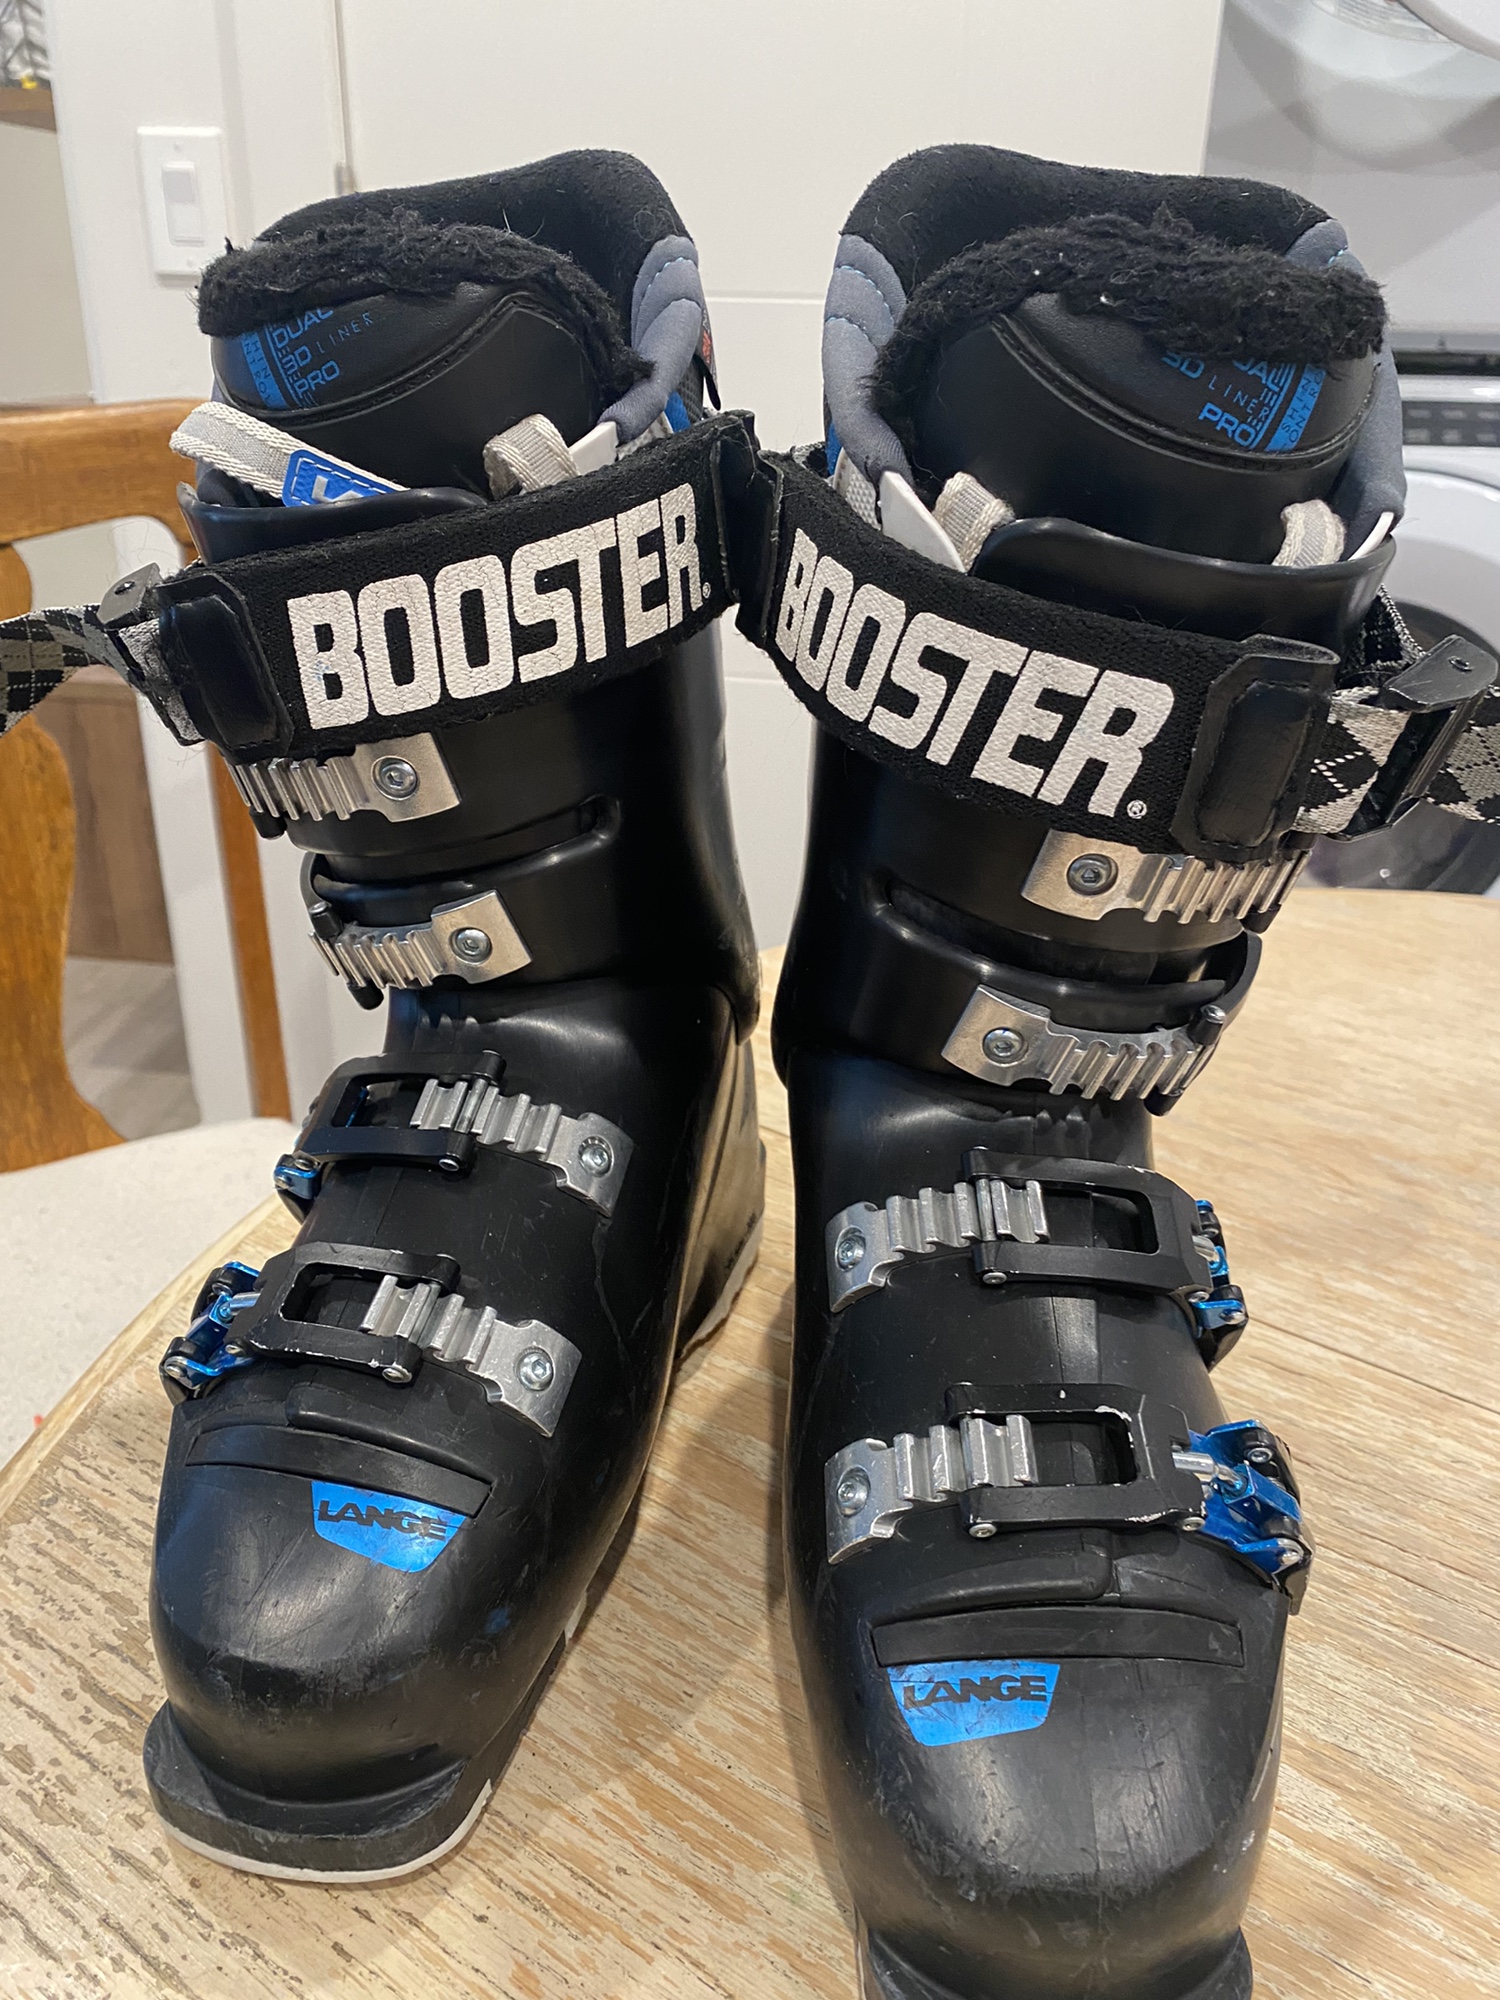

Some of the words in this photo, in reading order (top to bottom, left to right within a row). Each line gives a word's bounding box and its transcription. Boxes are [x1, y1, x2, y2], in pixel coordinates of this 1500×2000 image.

[251, 334, 272, 380] HIN
[282, 345, 312, 375] 3D
[293, 360, 340, 398] PRO
[1232, 358, 1281, 393] UAL
[1208, 374, 1270, 422] LINER
[1281, 377, 1312, 434] SHIN
[1198, 402, 1256, 447] PRO
[287, 483, 702, 729] BOOSTER
[775, 528, 1174, 818] BOOSTER
[318, 1500, 447, 1541] LANGE
[903, 1674, 1047, 1710] LANGE
